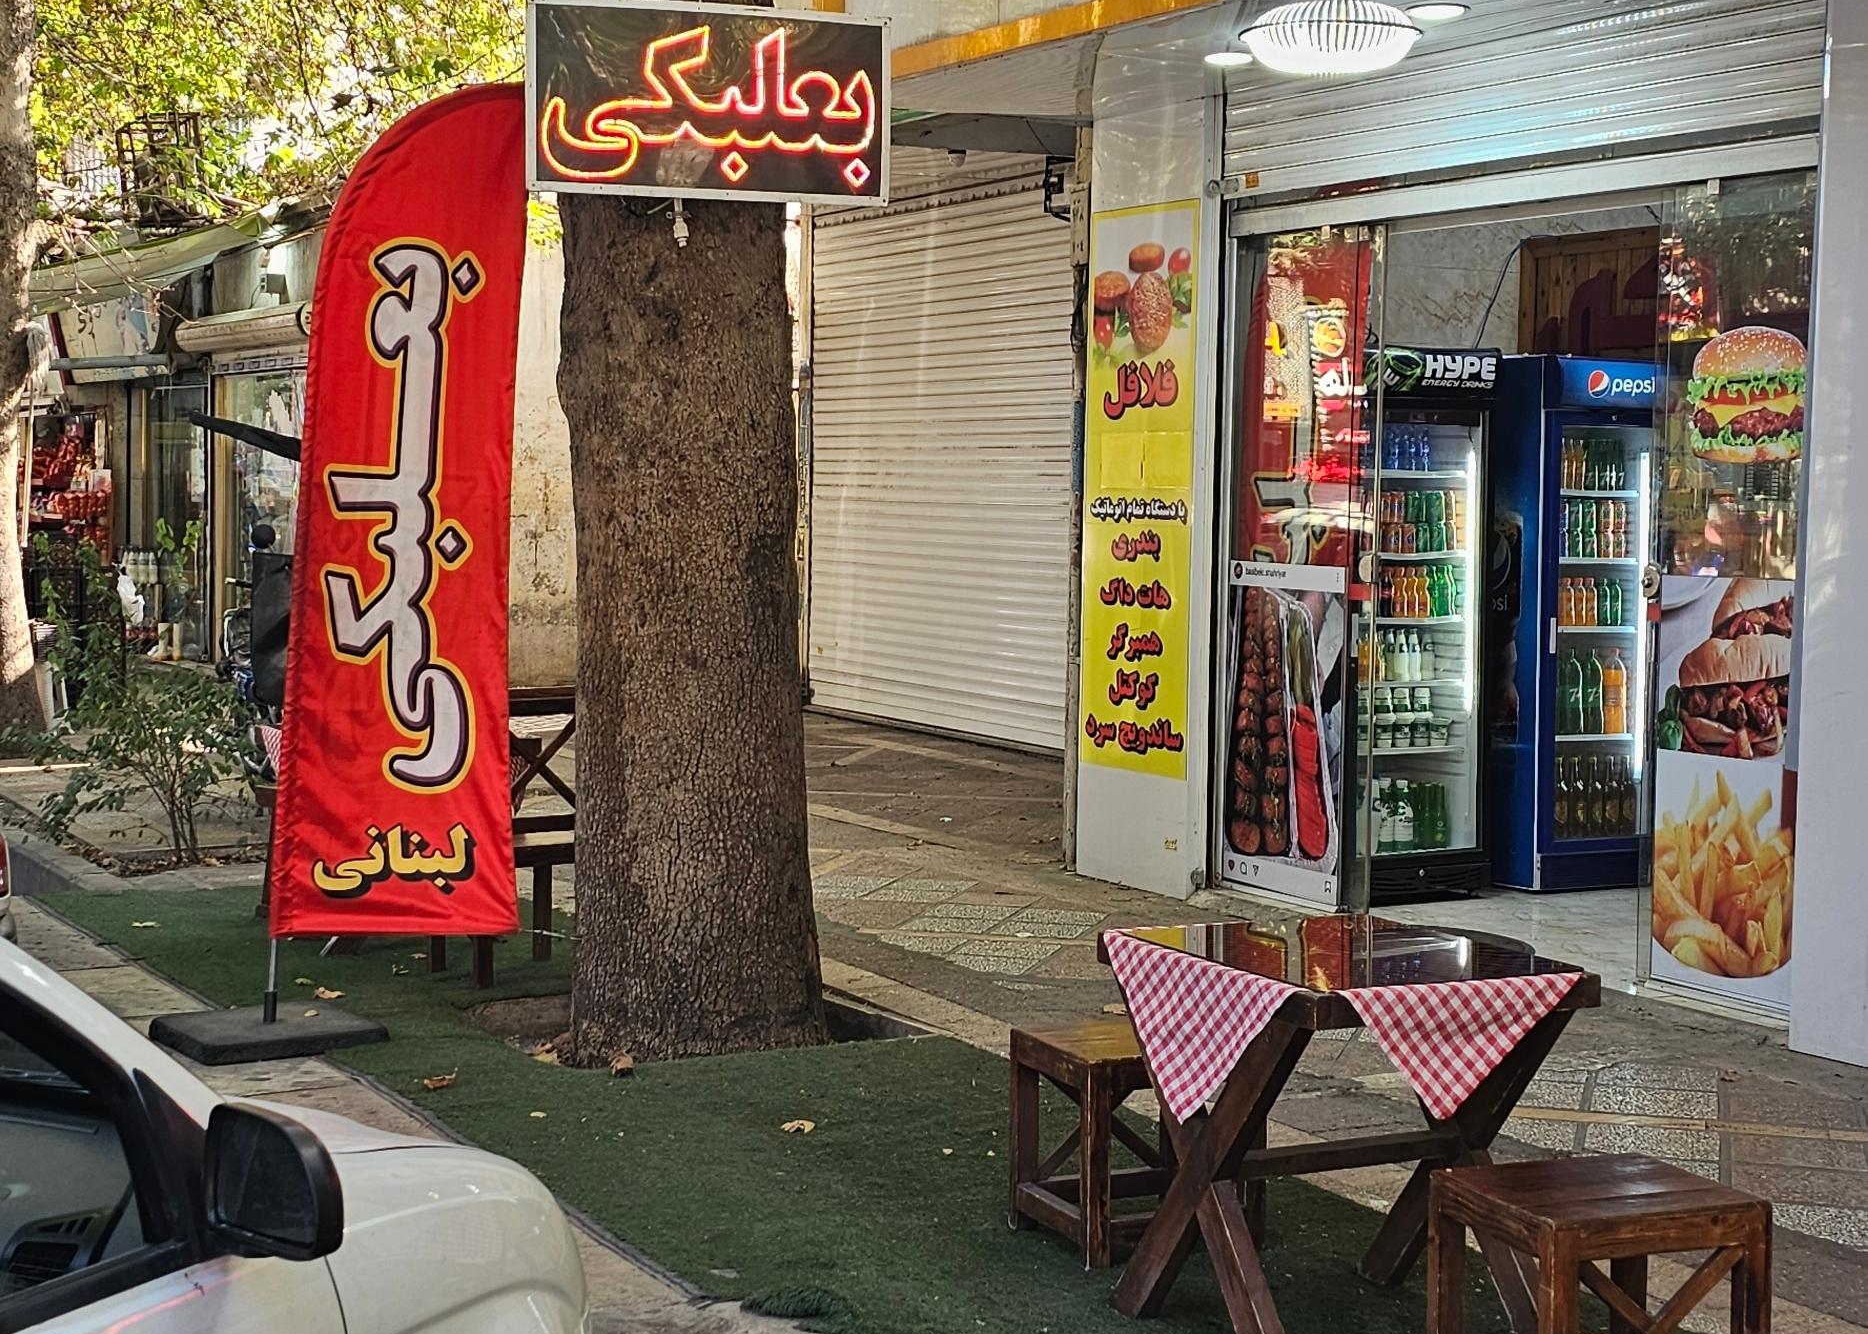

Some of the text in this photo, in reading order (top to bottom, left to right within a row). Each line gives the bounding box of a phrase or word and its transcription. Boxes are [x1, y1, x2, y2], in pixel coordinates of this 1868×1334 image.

[540, 24, 877, 188] بعلبکی
[1421, 378, 1460, 388] ENERGY
[1423, 354, 1497, 381] HYPE
[1104, 359, 1179, 420] فلافل
[1610, 376, 1656, 397] pepsi
[321, 237, 487, 795] بعلبکی
[1090, 496, 1188, 525] با دستگاه تمام اتوماتیک
[1111, 529, 1161, 562] بندری
[1136, 579, 1172, 610] هات
[1085, 713, 1184, 755] ساندویچ سرد
[313, 822, 477, 899] لبنانی
